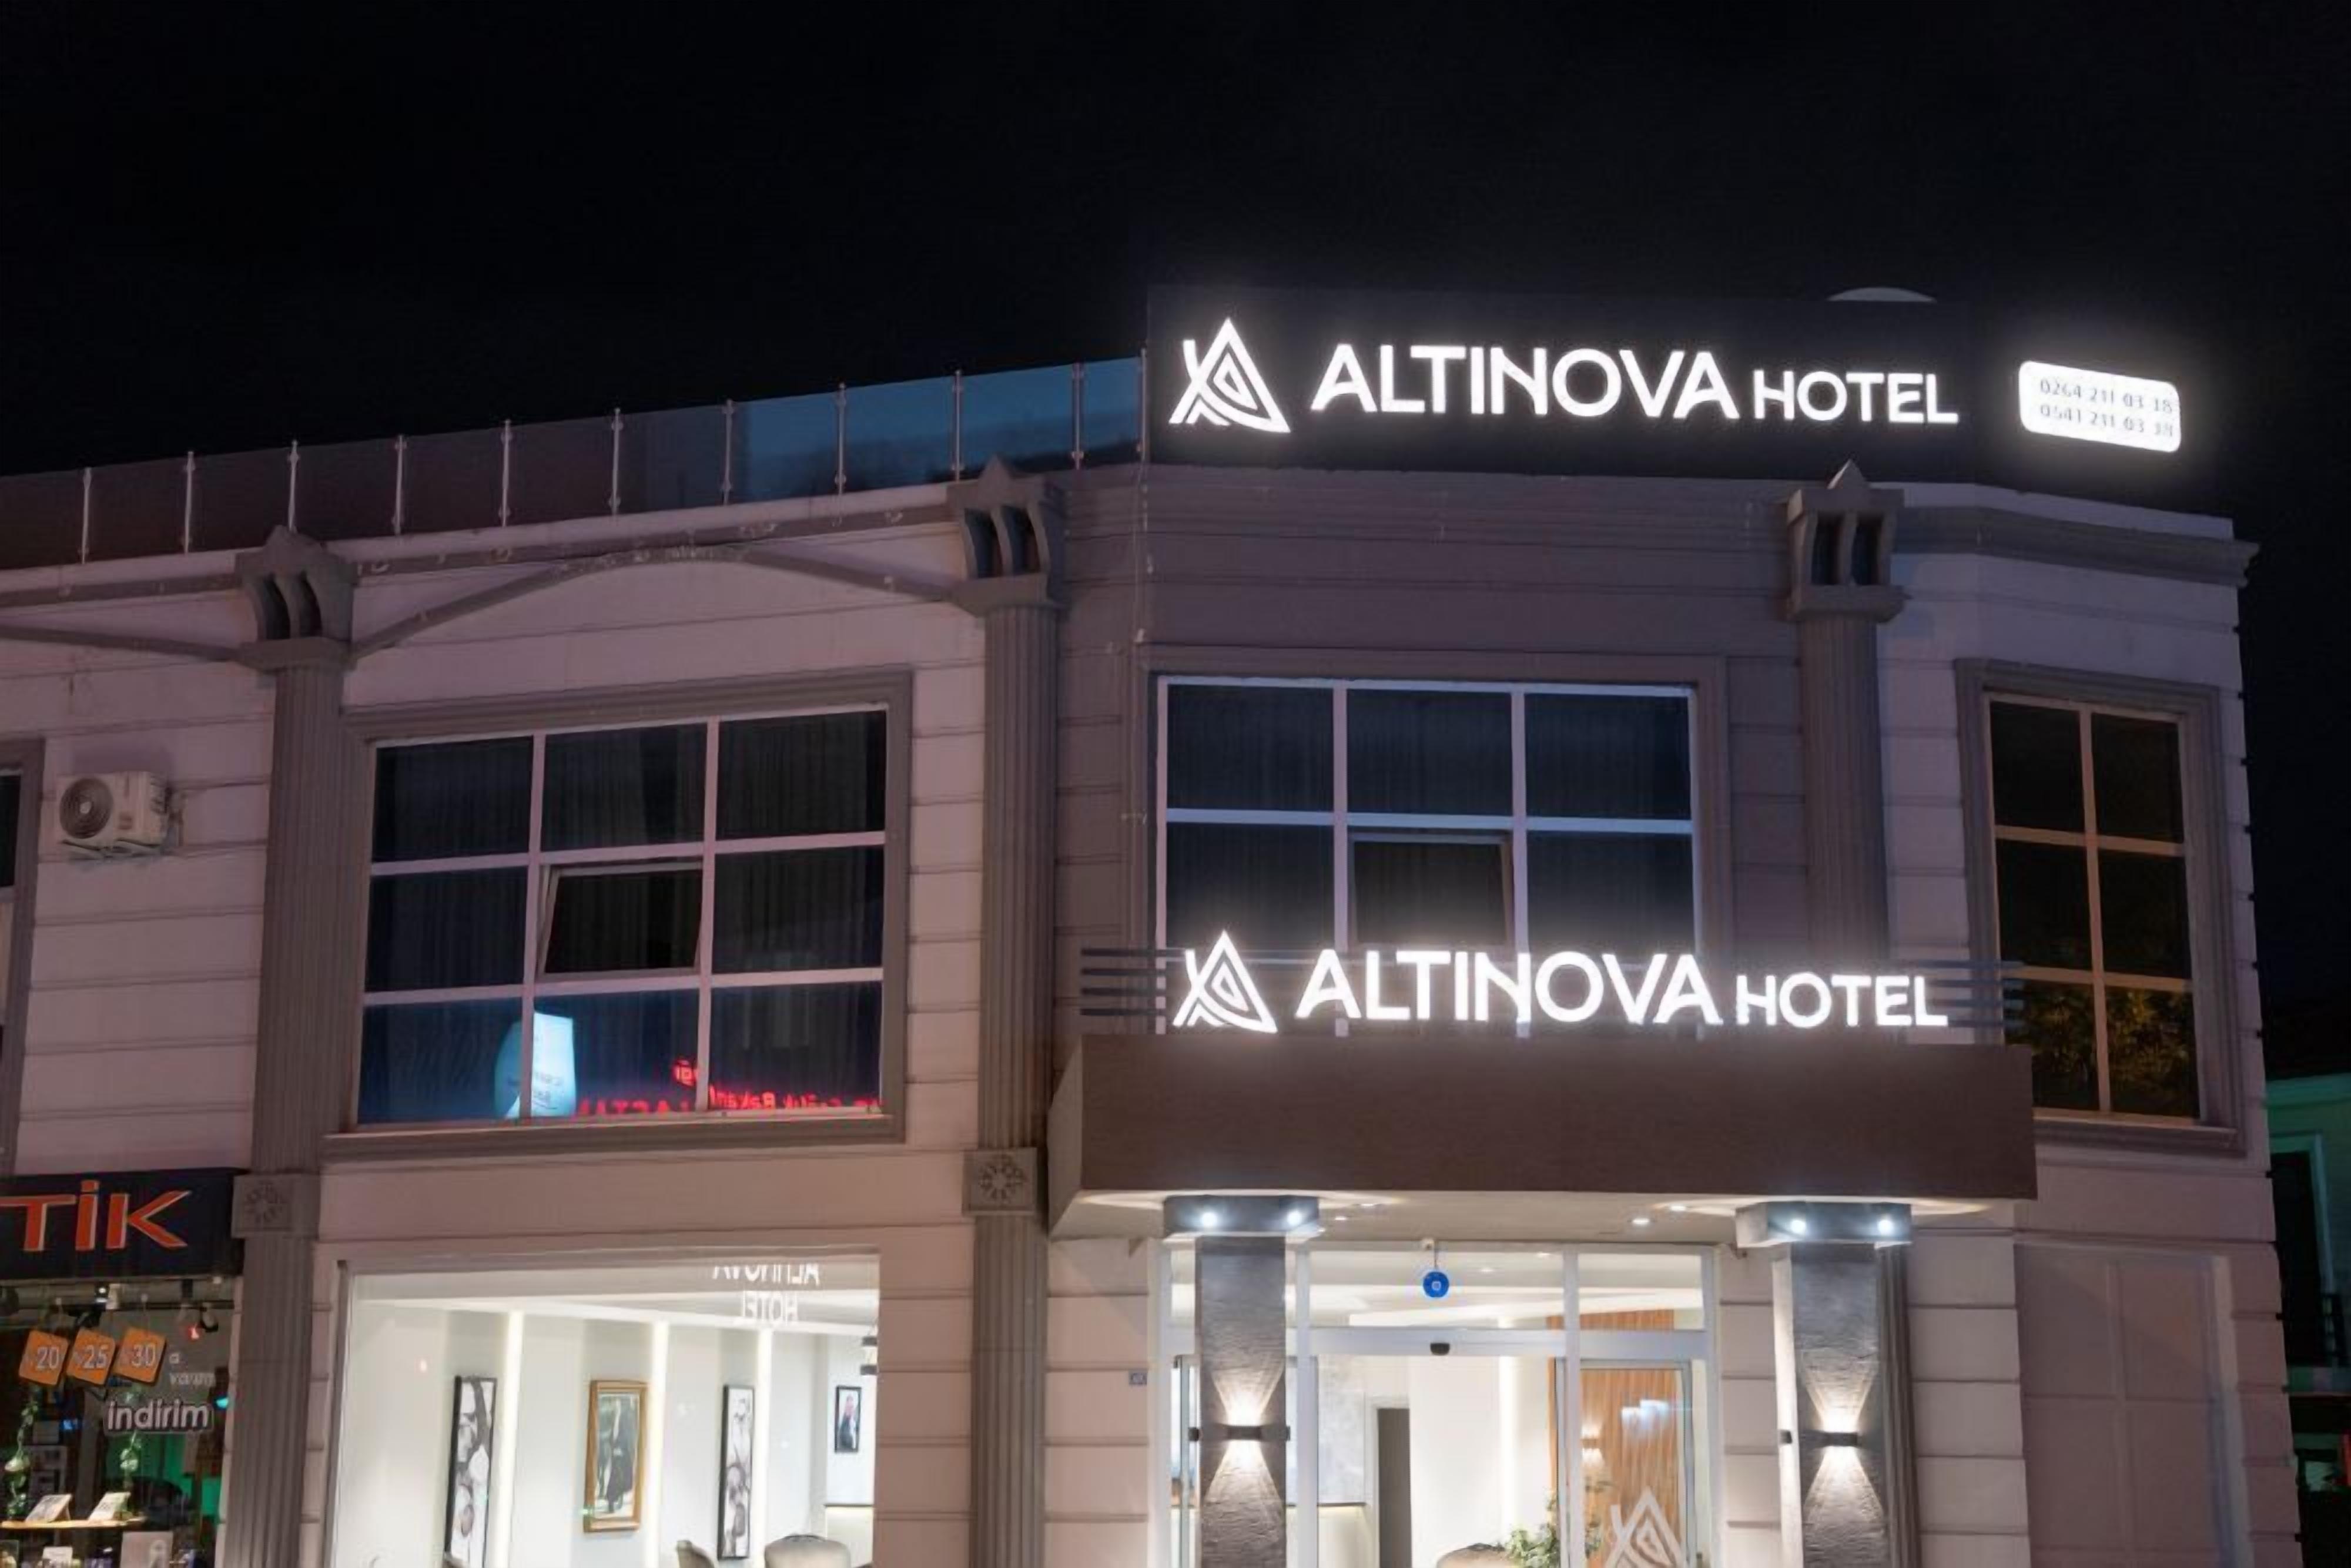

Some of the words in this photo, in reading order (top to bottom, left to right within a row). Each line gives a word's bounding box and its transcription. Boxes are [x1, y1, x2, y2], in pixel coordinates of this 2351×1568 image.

[1311, 343, 1740, 420] ALTINOVA
[1754, 370, 1959, 423] HOTEL
[1295, 948, 1723, 1024] ALTINOVA
[1736, 972, 1949, 1027] HOTEL
[36, 1347, 59, 1369] 20
[84, 1345, 107, 1369] 25
[132, 1345, 156, 1367] 30
[108, 1399, 209, 1430] indirim
